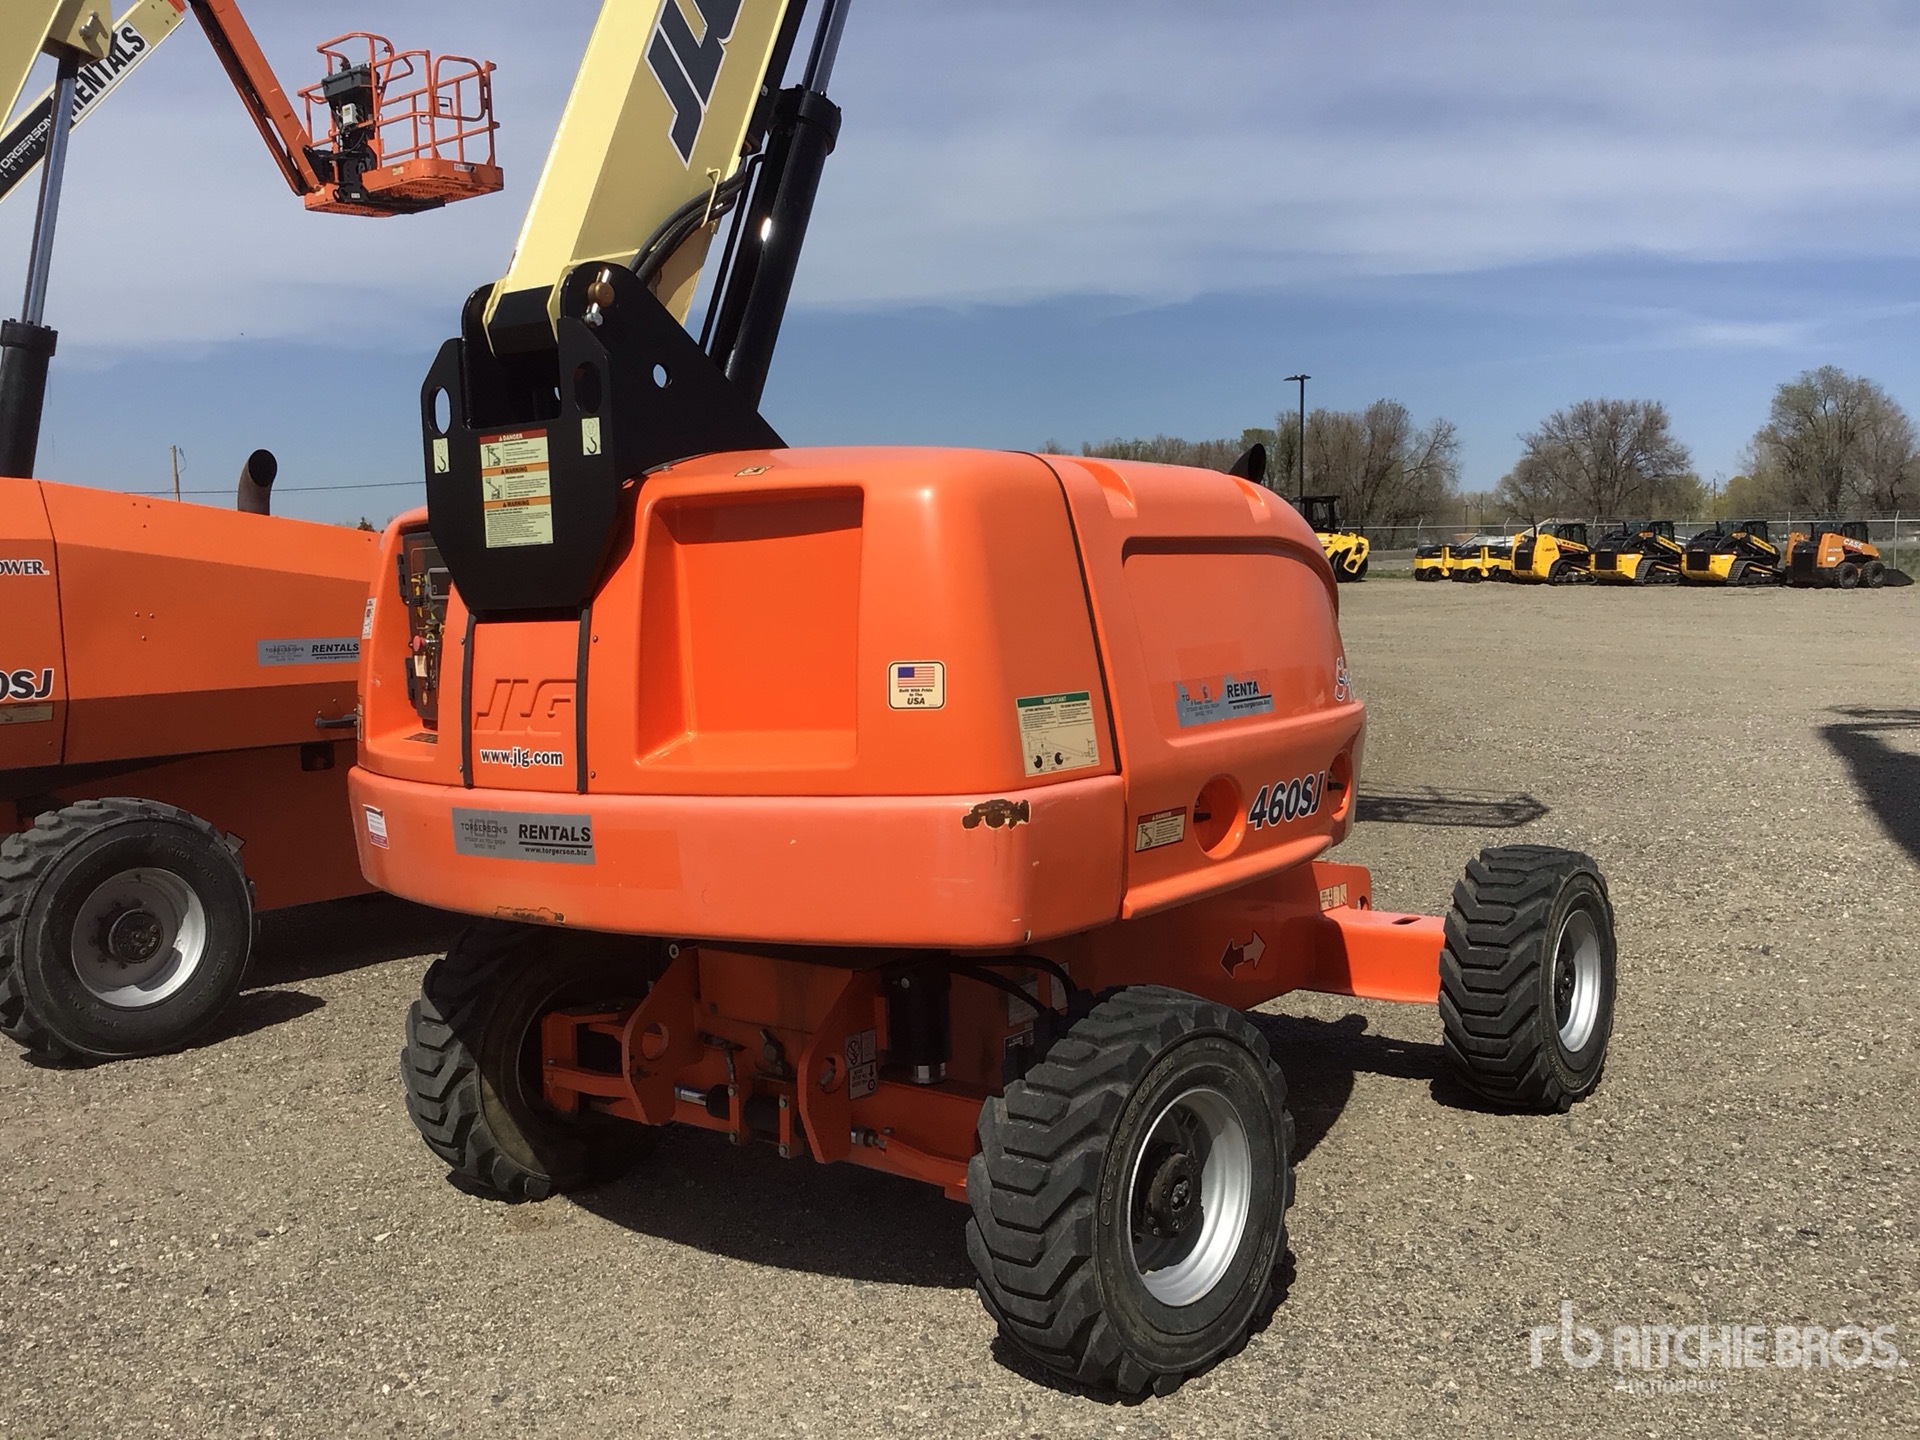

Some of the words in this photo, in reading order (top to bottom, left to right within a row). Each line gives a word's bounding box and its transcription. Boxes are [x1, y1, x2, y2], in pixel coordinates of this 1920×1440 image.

[503, 433, 523, 441] DANGER
[505, 466, 528, 474] WARNING
[507, 500, 530, 508] WARNING
[1843, 538, 1864, 550] CASE
[311, 643, 360, 653] RENTALS
[907, 697, 925, 705] USA
[1042, 696, 1067, 704] IMPORTANT
[473, 679, 577, 736] JLG
[480, 748, 564, 768] www.jlg.com
[1247, 771, 1325, 831] 460SJ
[461, 822, 508, 834] TORGERSON'S
[519, 824, 591, 843] RENTALS
[525, 846, 588, 856] www.torgerson.biz
